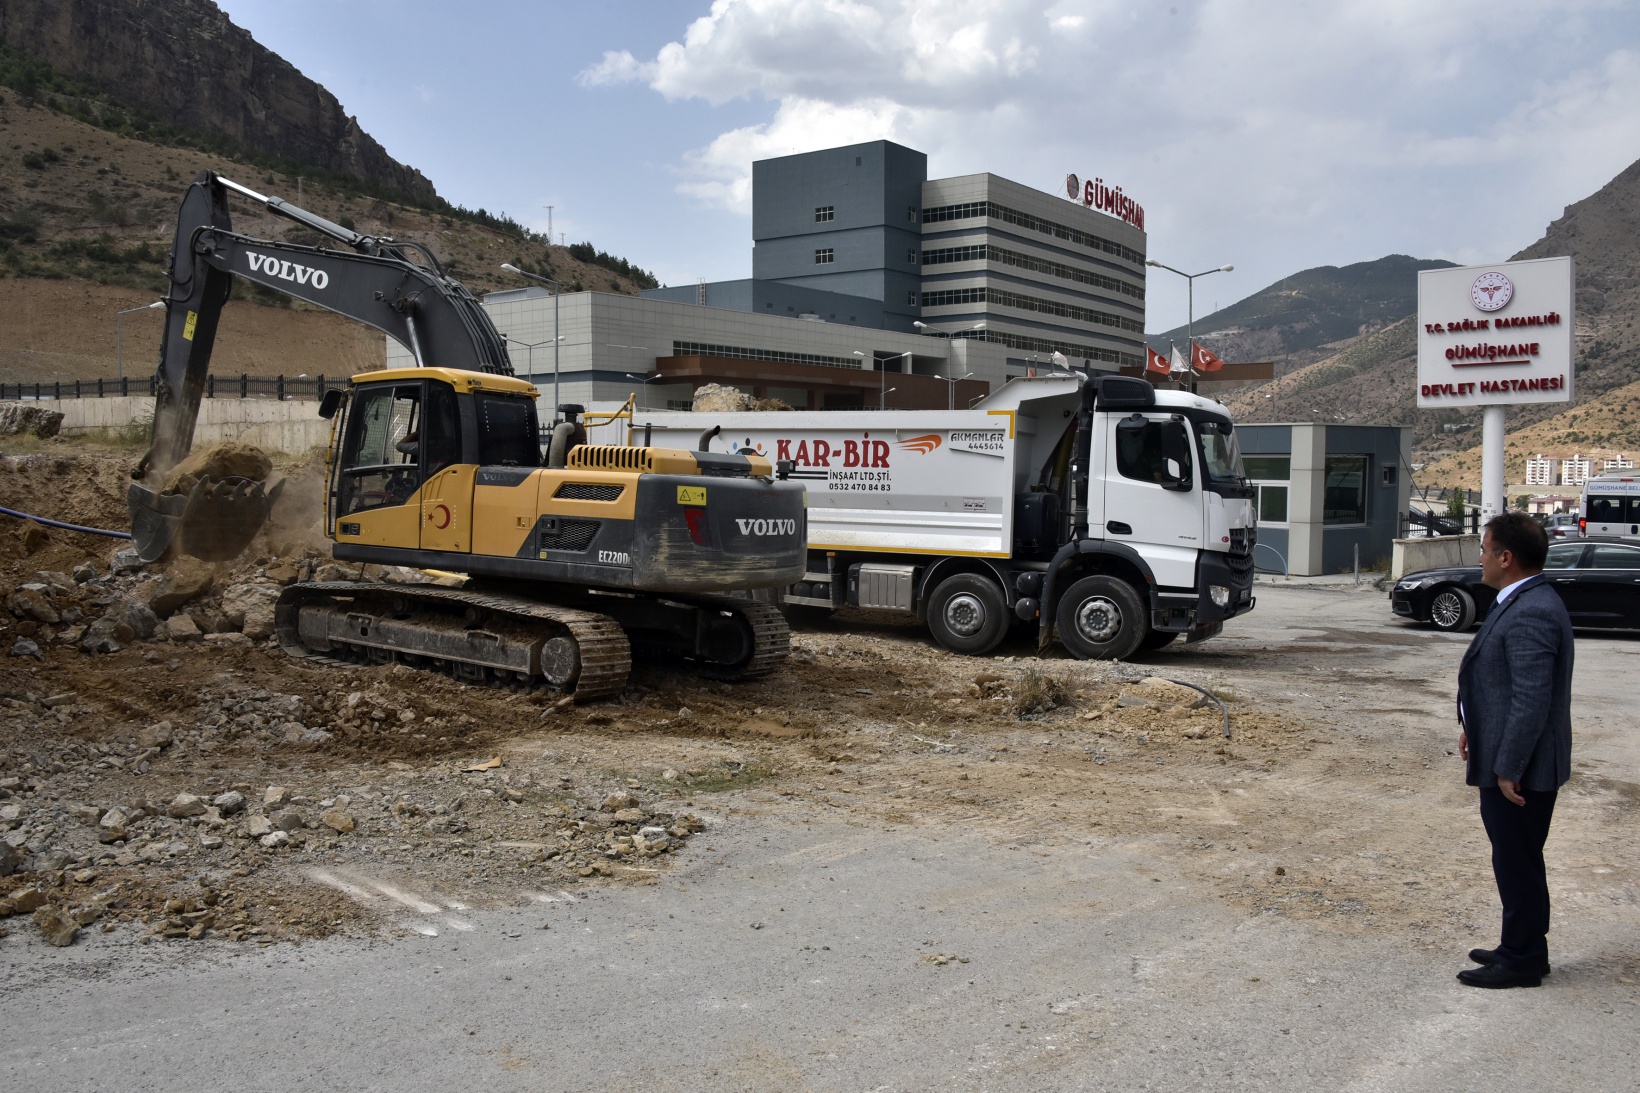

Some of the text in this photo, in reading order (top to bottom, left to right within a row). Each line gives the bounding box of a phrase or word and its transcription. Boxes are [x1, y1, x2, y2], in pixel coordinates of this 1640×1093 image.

[246, 251, 329, 290] VOLVO
[1424, 312, 1560, 334] T.C. SAĞLIK BAKANLIĞI
[1445, 342, 1540, 361] GÜMÜŞHANE
[1421, 374, 1564, 397] DEVLET HASTANESİ
[950, 432, 1004, 442] AKMANLAR
[968, 442, 1004, 450] 4445614
[776, 432, 890, 468] KAR-BİR
[829, 469, 859, 483] İNŞAAT
[829, 482, 891, 492] 0532 470 84 83
[735, 518, 796, 537] VOLVO
